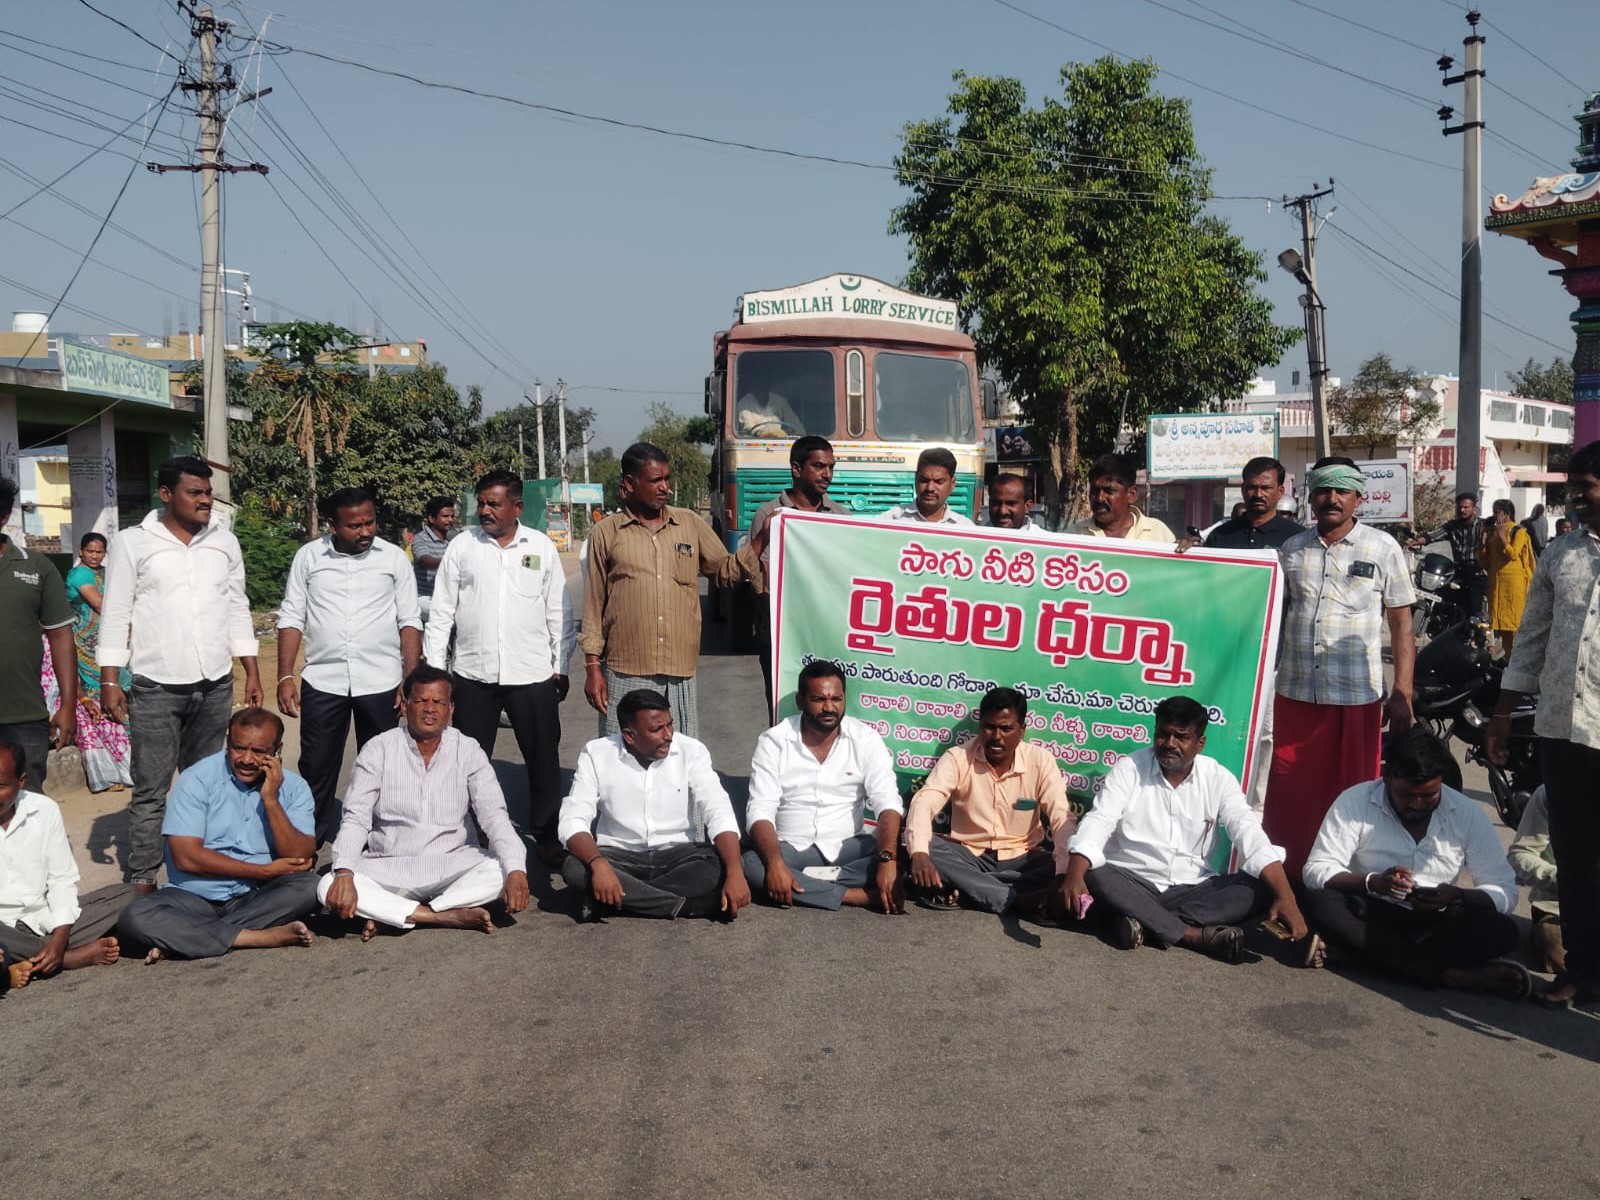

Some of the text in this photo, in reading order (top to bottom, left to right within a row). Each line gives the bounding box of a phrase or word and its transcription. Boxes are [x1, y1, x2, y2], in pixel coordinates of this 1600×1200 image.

[747, 296, 955, 326] BISMILLAH LORRY SERVICE
[900, 543, 1128, 593] సాగు నీటి కోసం
[848, 578, 1192, 683] రైతుల ధర్నా
[862, 664, 943, 688] పారుతుంది
[861, 694, 910, 712] రావాలి
[916, 702, 967, 719] రావాలి
[895, 724, 952, 744] నిండాలి
